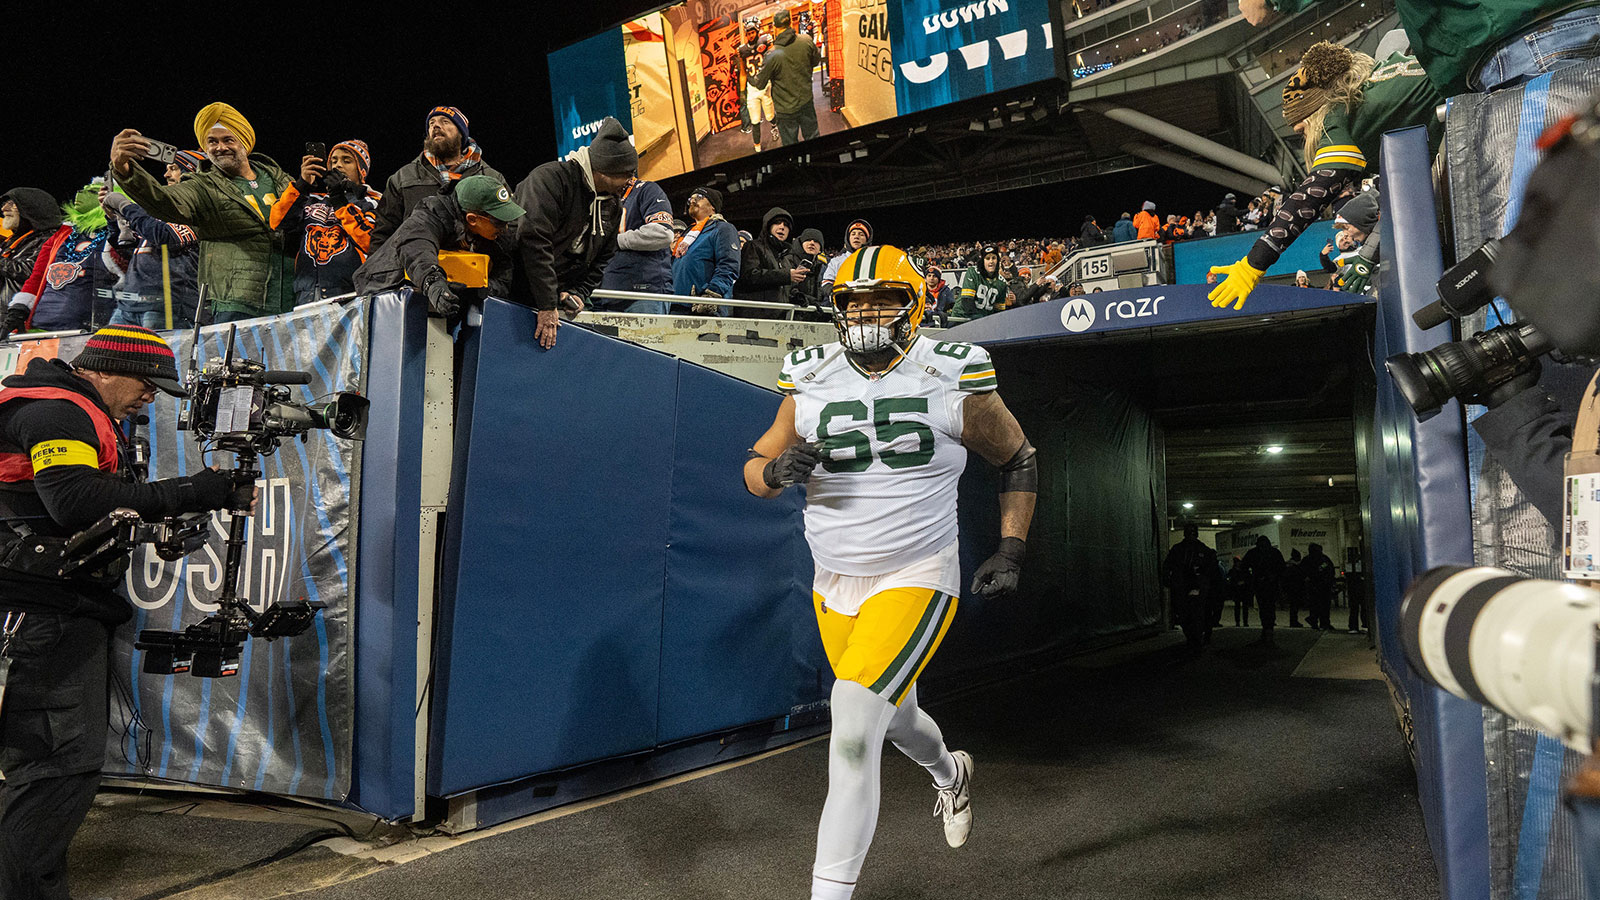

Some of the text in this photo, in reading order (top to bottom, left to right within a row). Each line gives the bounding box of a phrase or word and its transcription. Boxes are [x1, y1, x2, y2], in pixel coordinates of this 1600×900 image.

[859, 42, 894, 87] REG
[1082, 259, 1109, 276] 155
[975, 283, 999, 311] 90
[1105, 295, 1166, 321] razr
[816, 397, 935, 474] 65
[32, 447, 56, 461] WEEK
[1290, 527, 1327, 538] Wheaton
